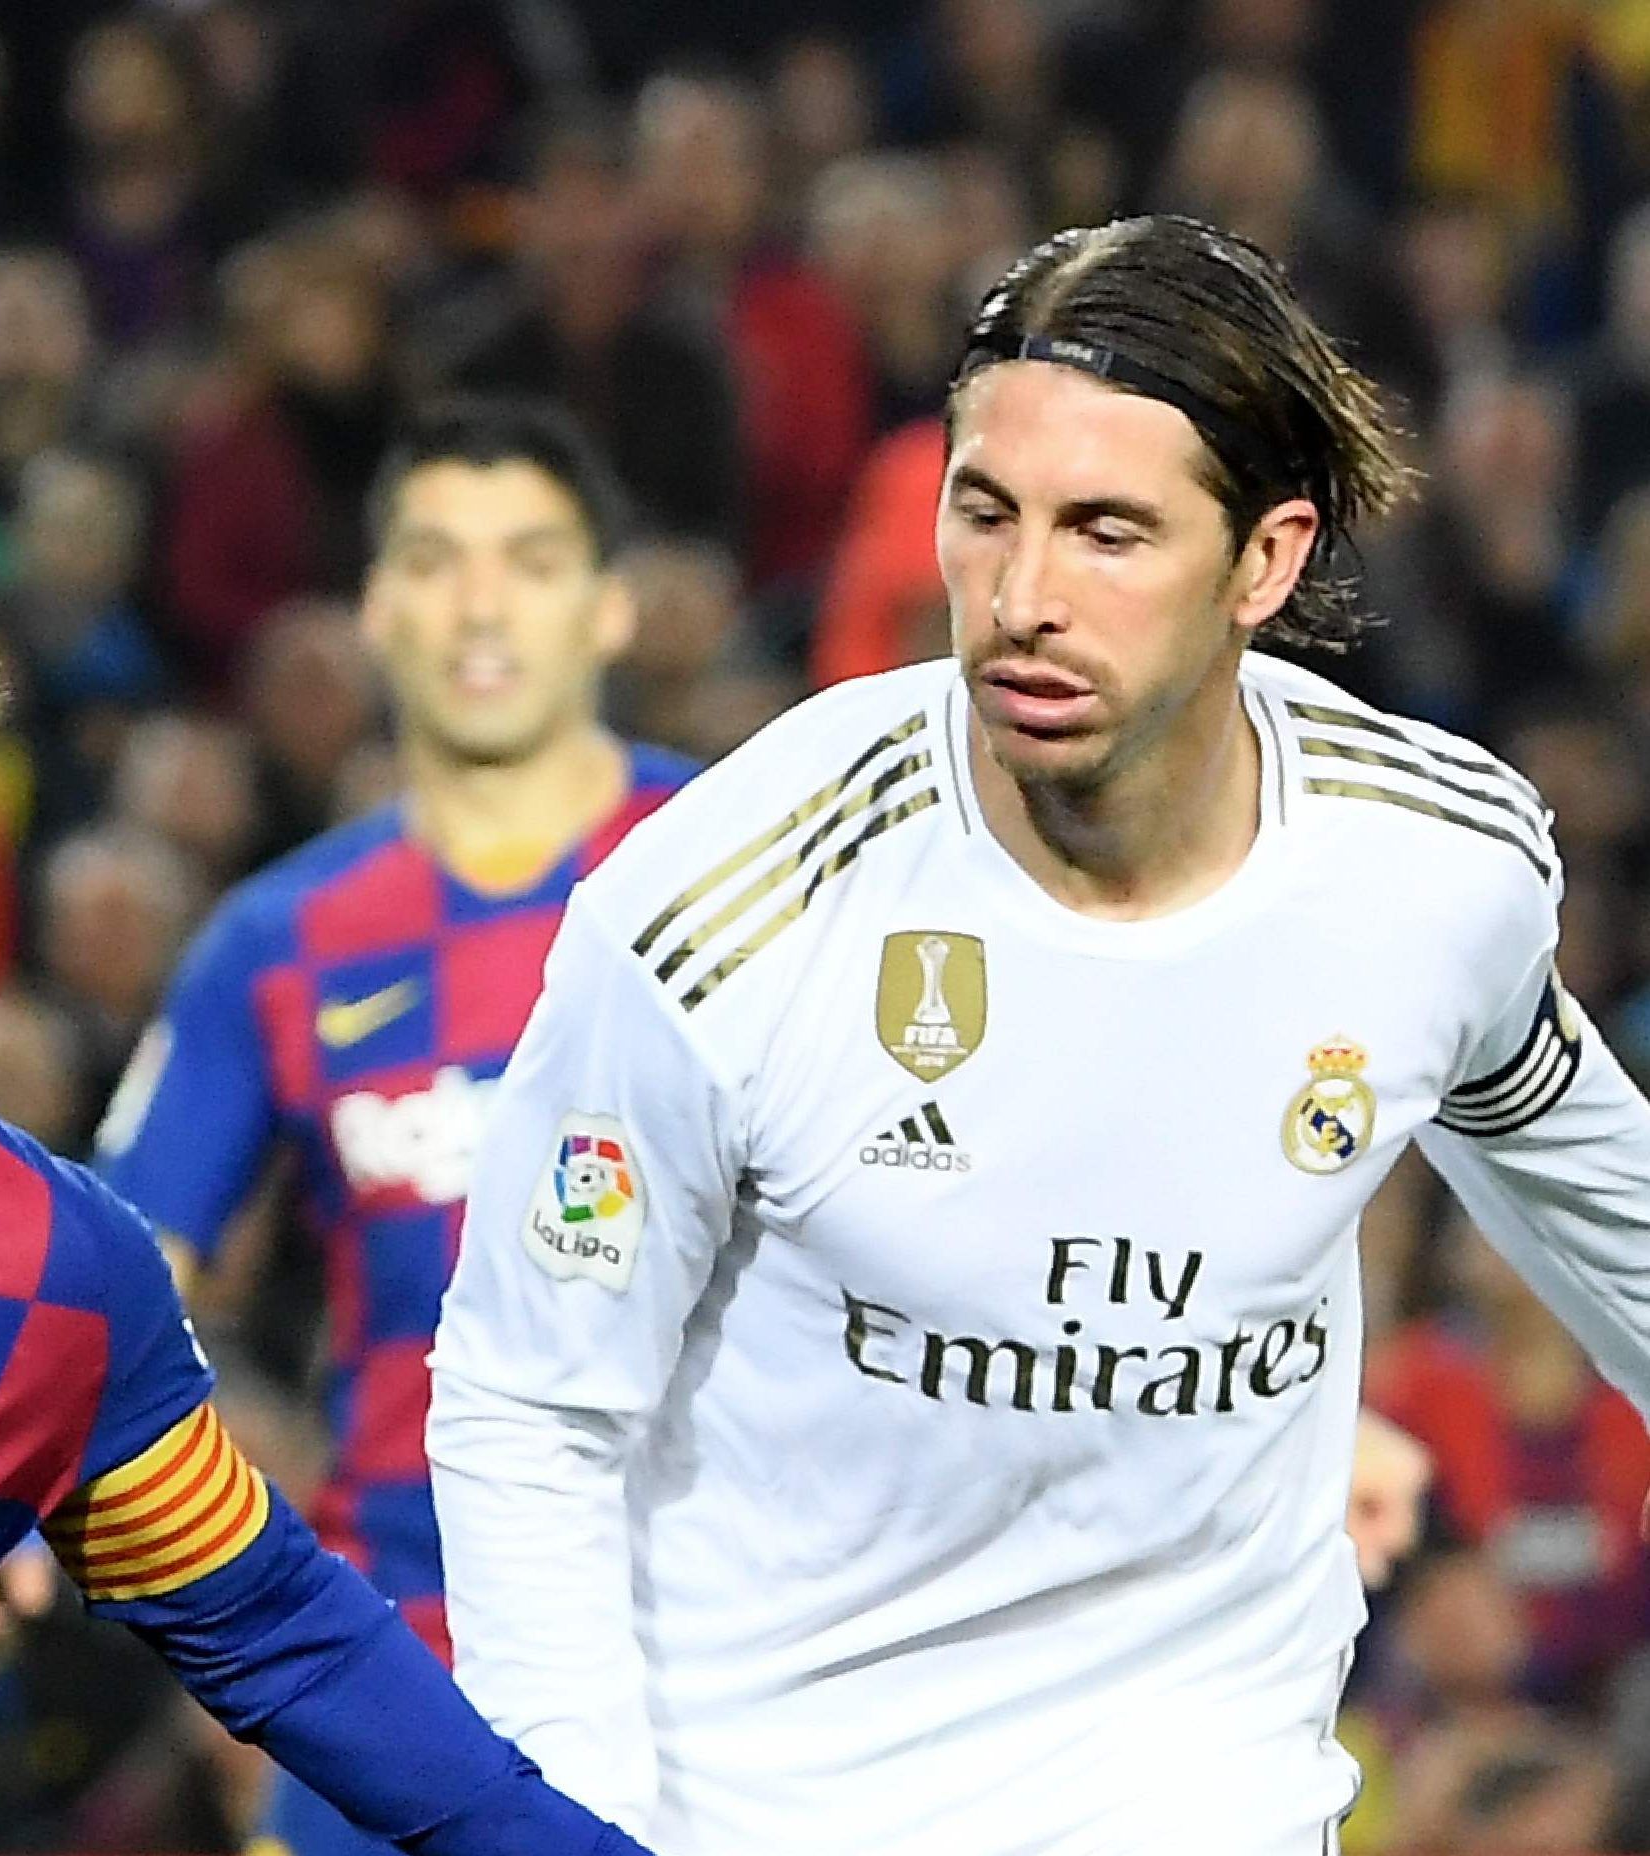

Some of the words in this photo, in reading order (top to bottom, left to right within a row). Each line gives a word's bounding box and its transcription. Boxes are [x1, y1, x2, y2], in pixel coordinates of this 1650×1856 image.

[904, 1025, 958, 1047] FIFA
[858, 1138, 971, 1173] adidas
[533, 1208, 621, 1265] LaLiga
[1046, 1236, 1203, 1321] Fly
[840, 1282, 1329, 1417] Emirates
